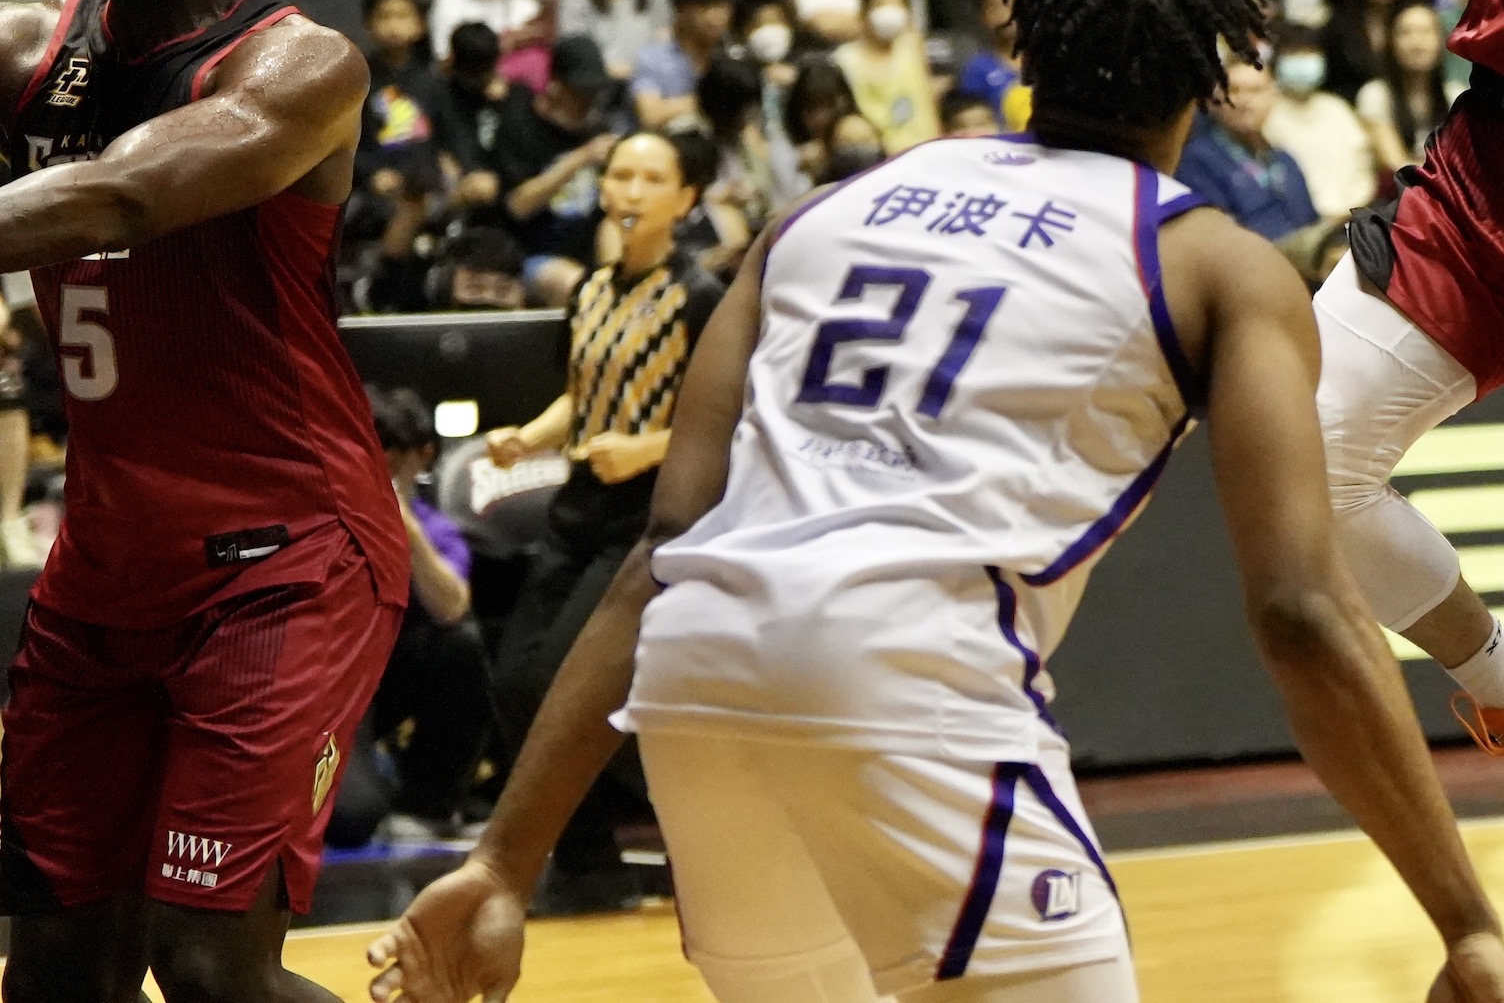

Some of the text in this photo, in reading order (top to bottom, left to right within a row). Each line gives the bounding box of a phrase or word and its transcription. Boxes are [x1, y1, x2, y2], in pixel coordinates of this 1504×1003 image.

[863, 184, 1077, 248] 伊波卡
[58, 283, 119, 401] 5
[793, 263, 1008, 419] 21
